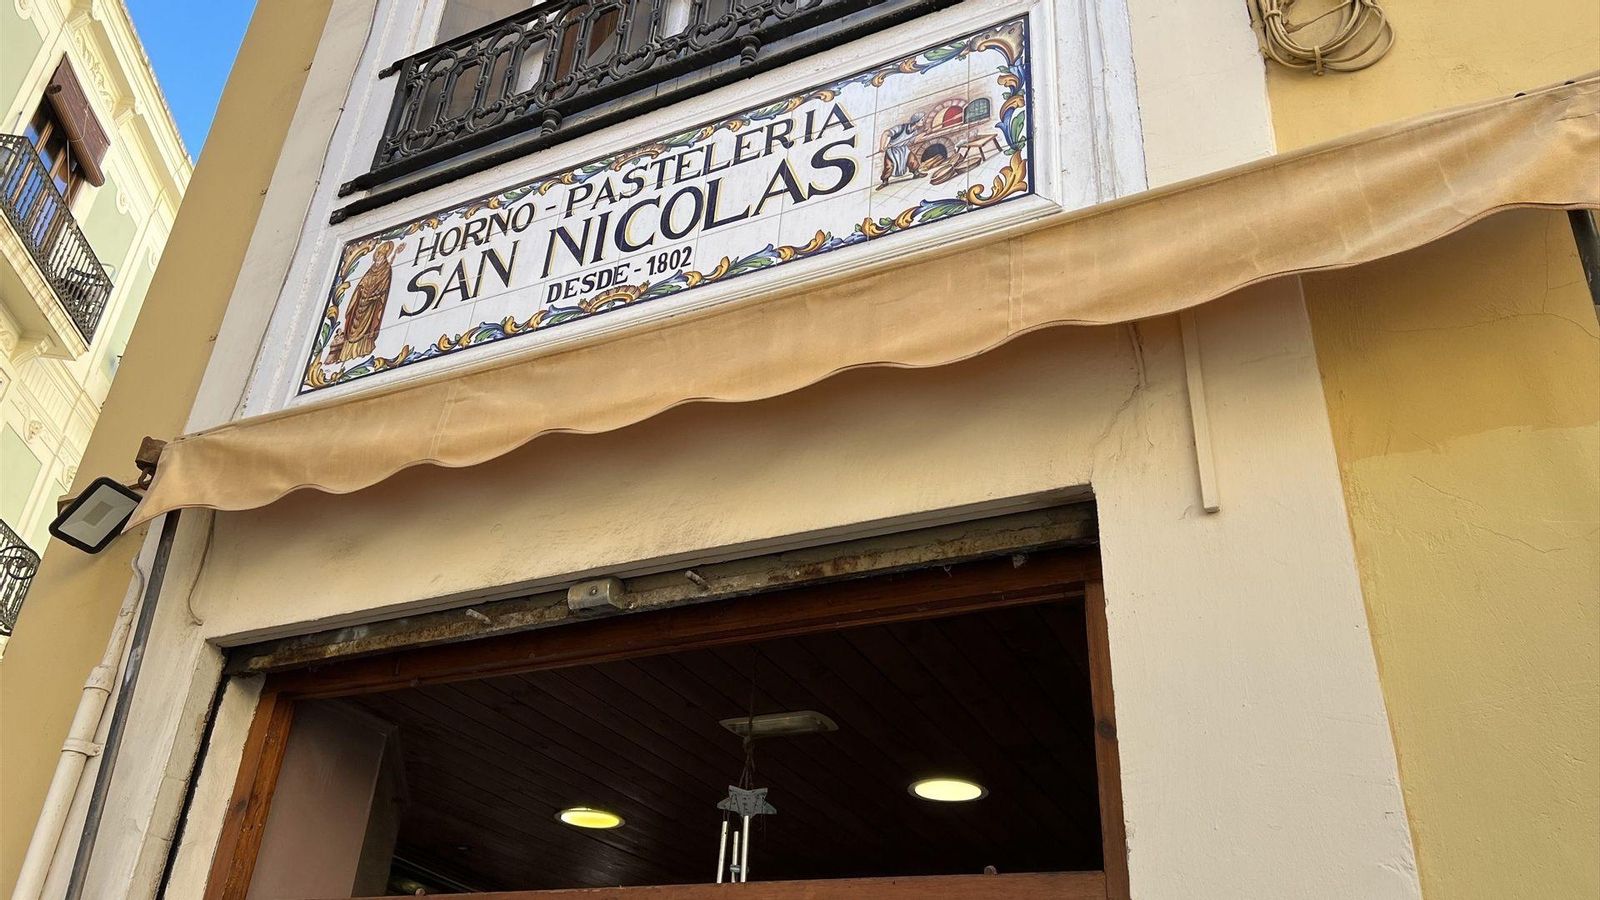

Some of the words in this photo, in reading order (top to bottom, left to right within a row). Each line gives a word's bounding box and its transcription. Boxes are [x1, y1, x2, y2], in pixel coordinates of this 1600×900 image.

[399, 240, 520, 319] SAN
[541, 135, 857, 279] NICOLAS
[412, 202, 535, 267] HORNO
[565, 102, 854, 219] PASTELERIA
[545, 262, 630, 304] DESDE
